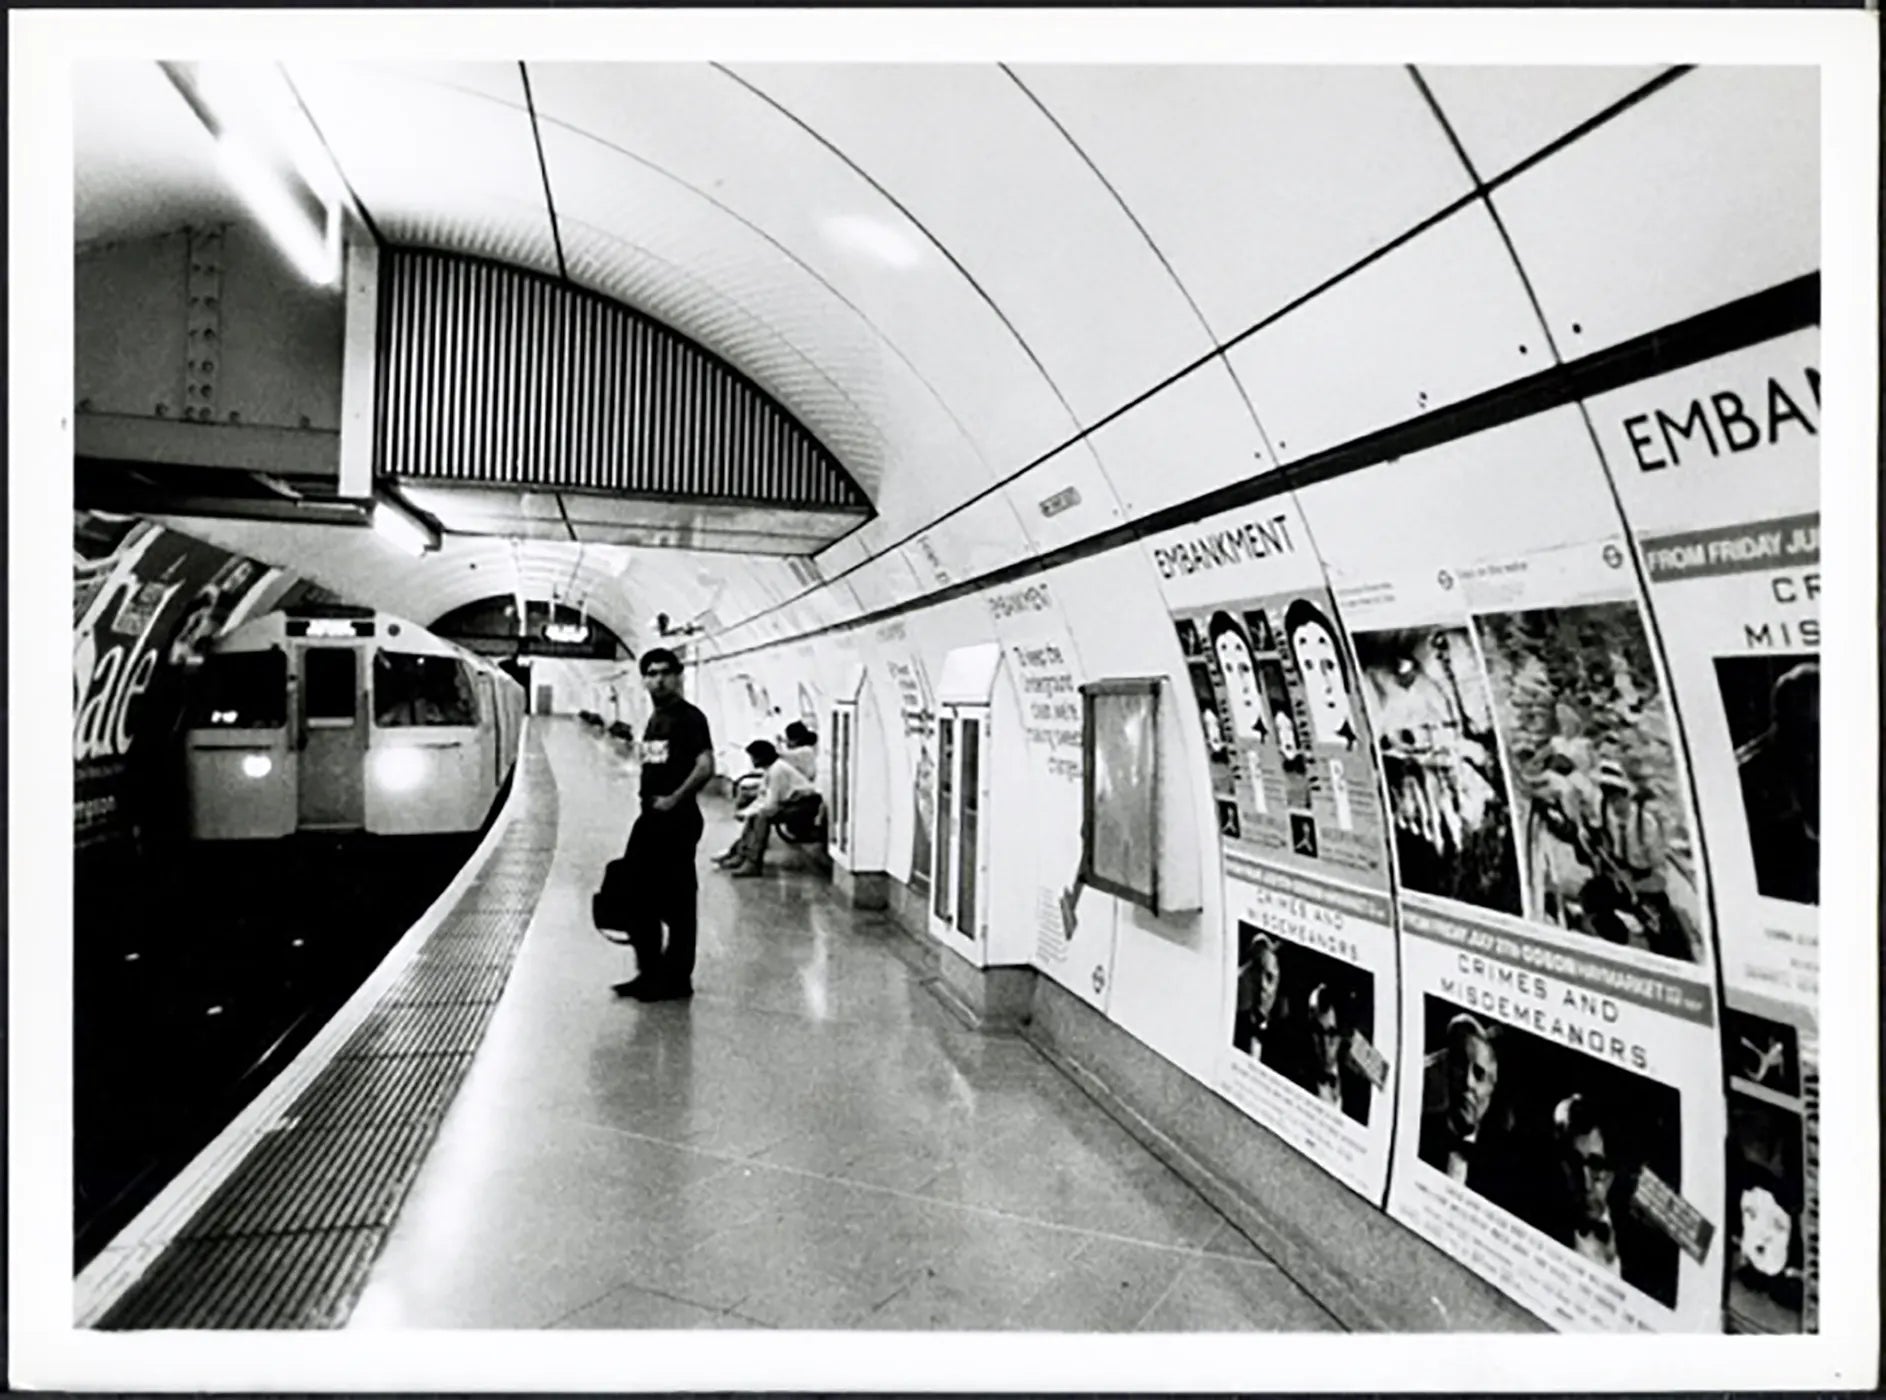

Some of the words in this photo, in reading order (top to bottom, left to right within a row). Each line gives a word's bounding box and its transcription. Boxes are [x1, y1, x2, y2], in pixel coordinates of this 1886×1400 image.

[1622, 367, 1820, 472] EMBA
[1154, 514, 1295, 579] EMBANKMENT
[1647, 543, 1706, 571] FROM
[1708, 531, 1782, 564] FRIDAY
[1744, 618, 1820, 648] MIS
[1458, 952, 1548, 1001] CRIMES
[1563, 988, 1619, 1023] AND
[1440, 977, 1648, 1069] MISDEMEANORS
